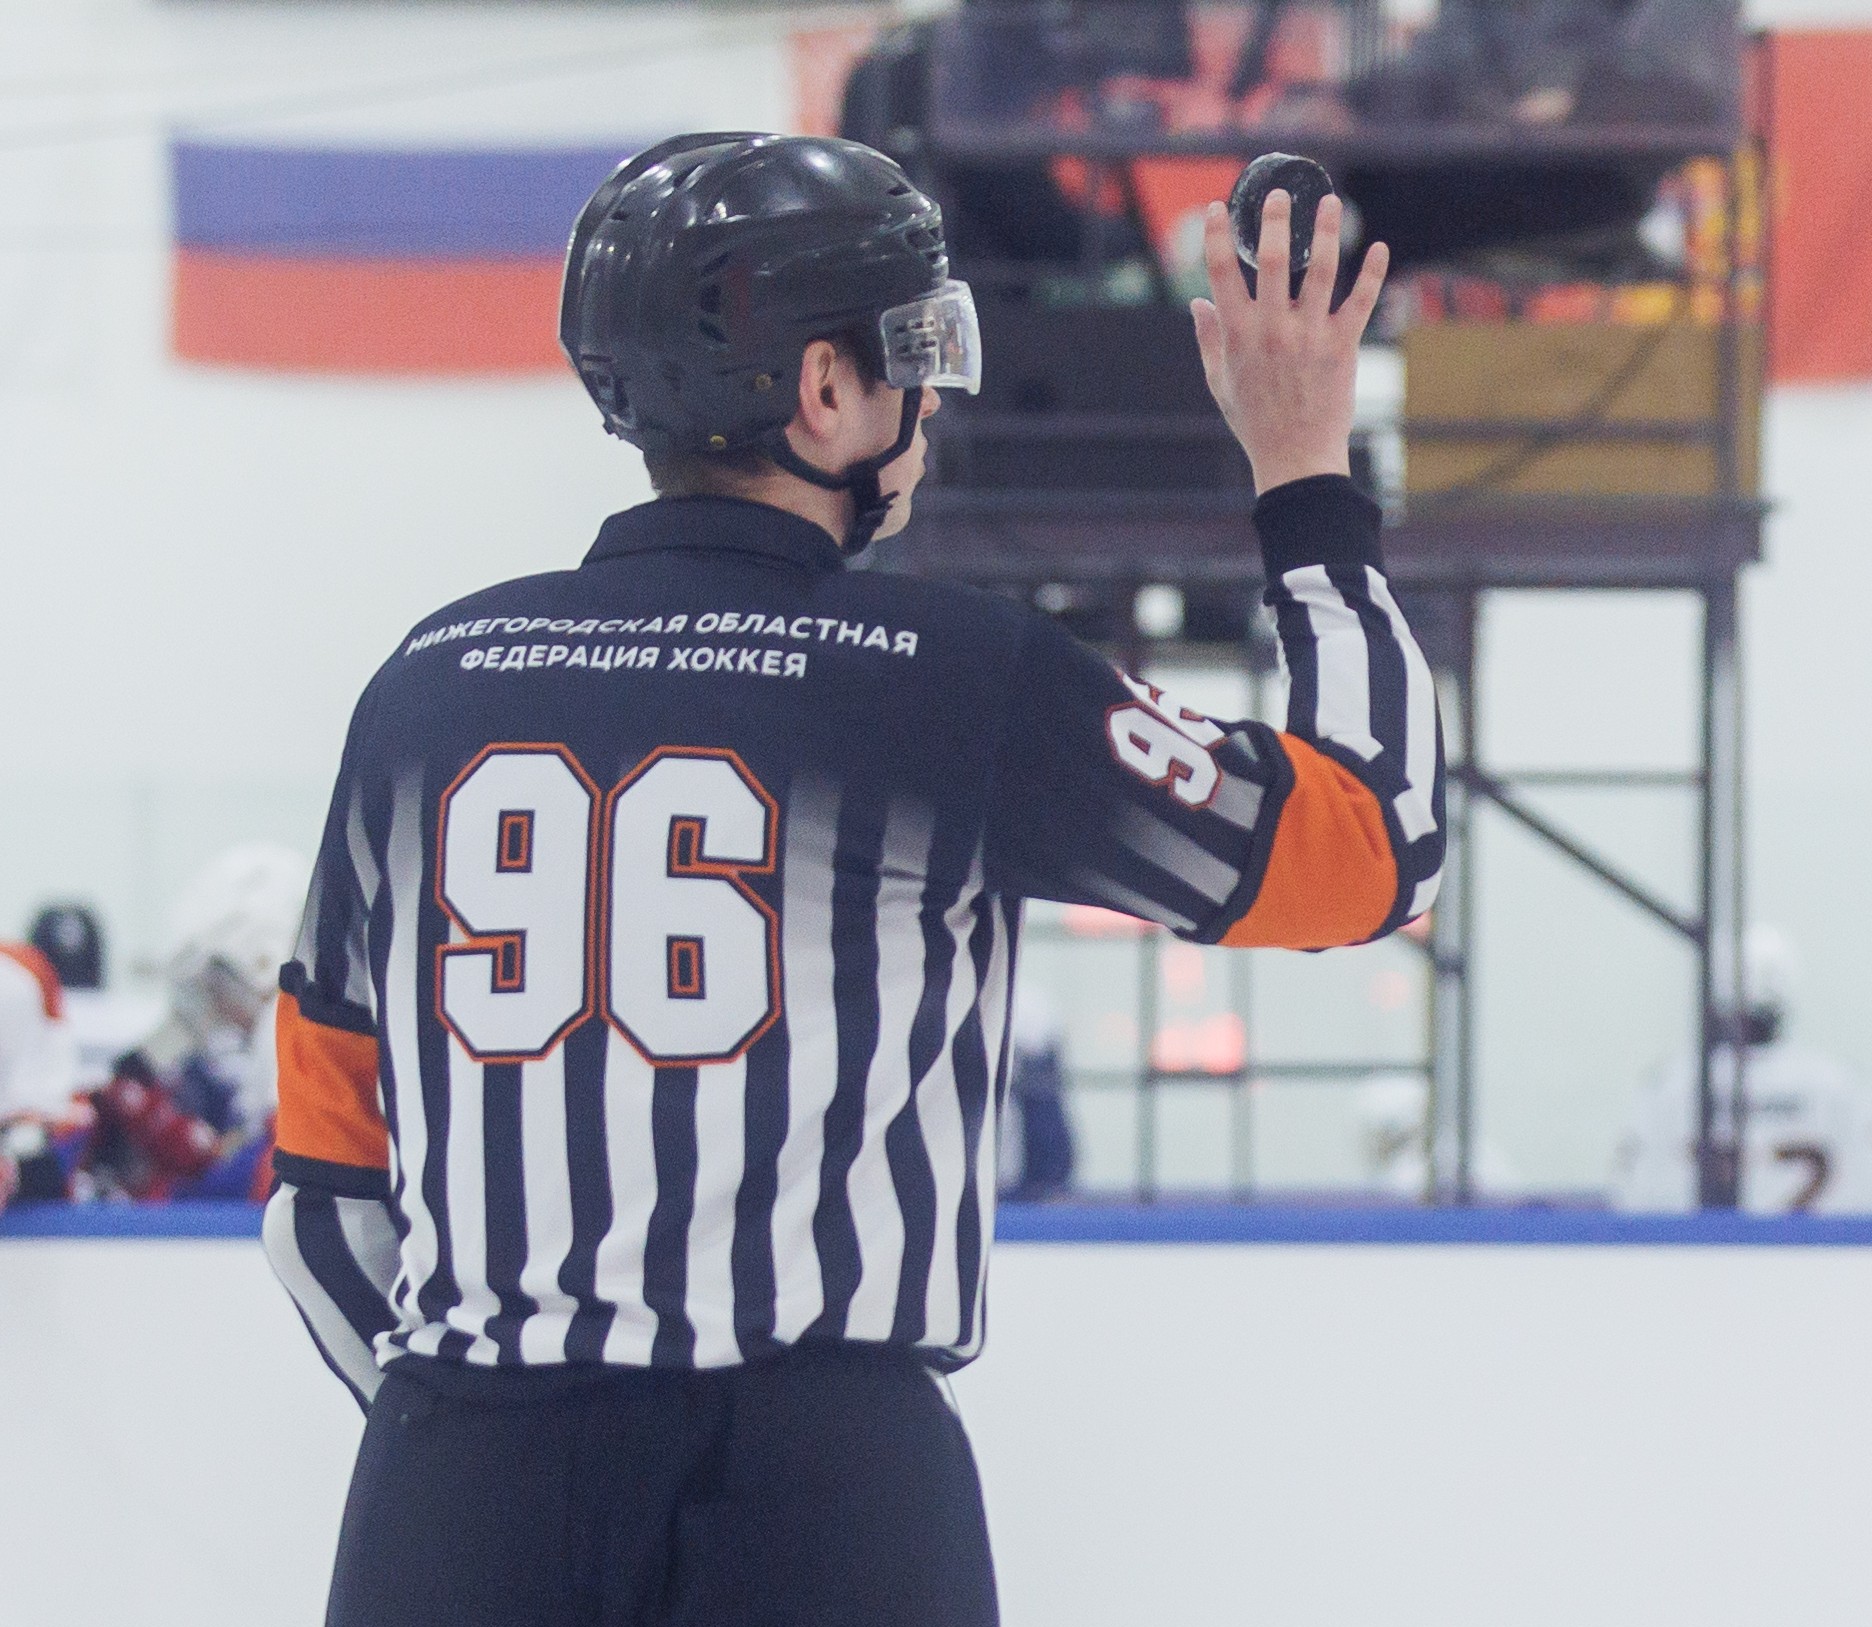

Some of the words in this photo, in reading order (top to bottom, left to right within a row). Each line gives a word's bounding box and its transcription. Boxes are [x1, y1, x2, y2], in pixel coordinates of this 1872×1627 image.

[404, 613, 688, 657] НИЖЕГОРОДСКАЯ
[695, 611, 919, 658] ОБЛАСТНАЯ
[459, 643, 660, 672] ФЕДЕРАЦИЯ
[670, 645, 808, 678] ХОККЕЯ
[434, 740, 782, 1067] 96
